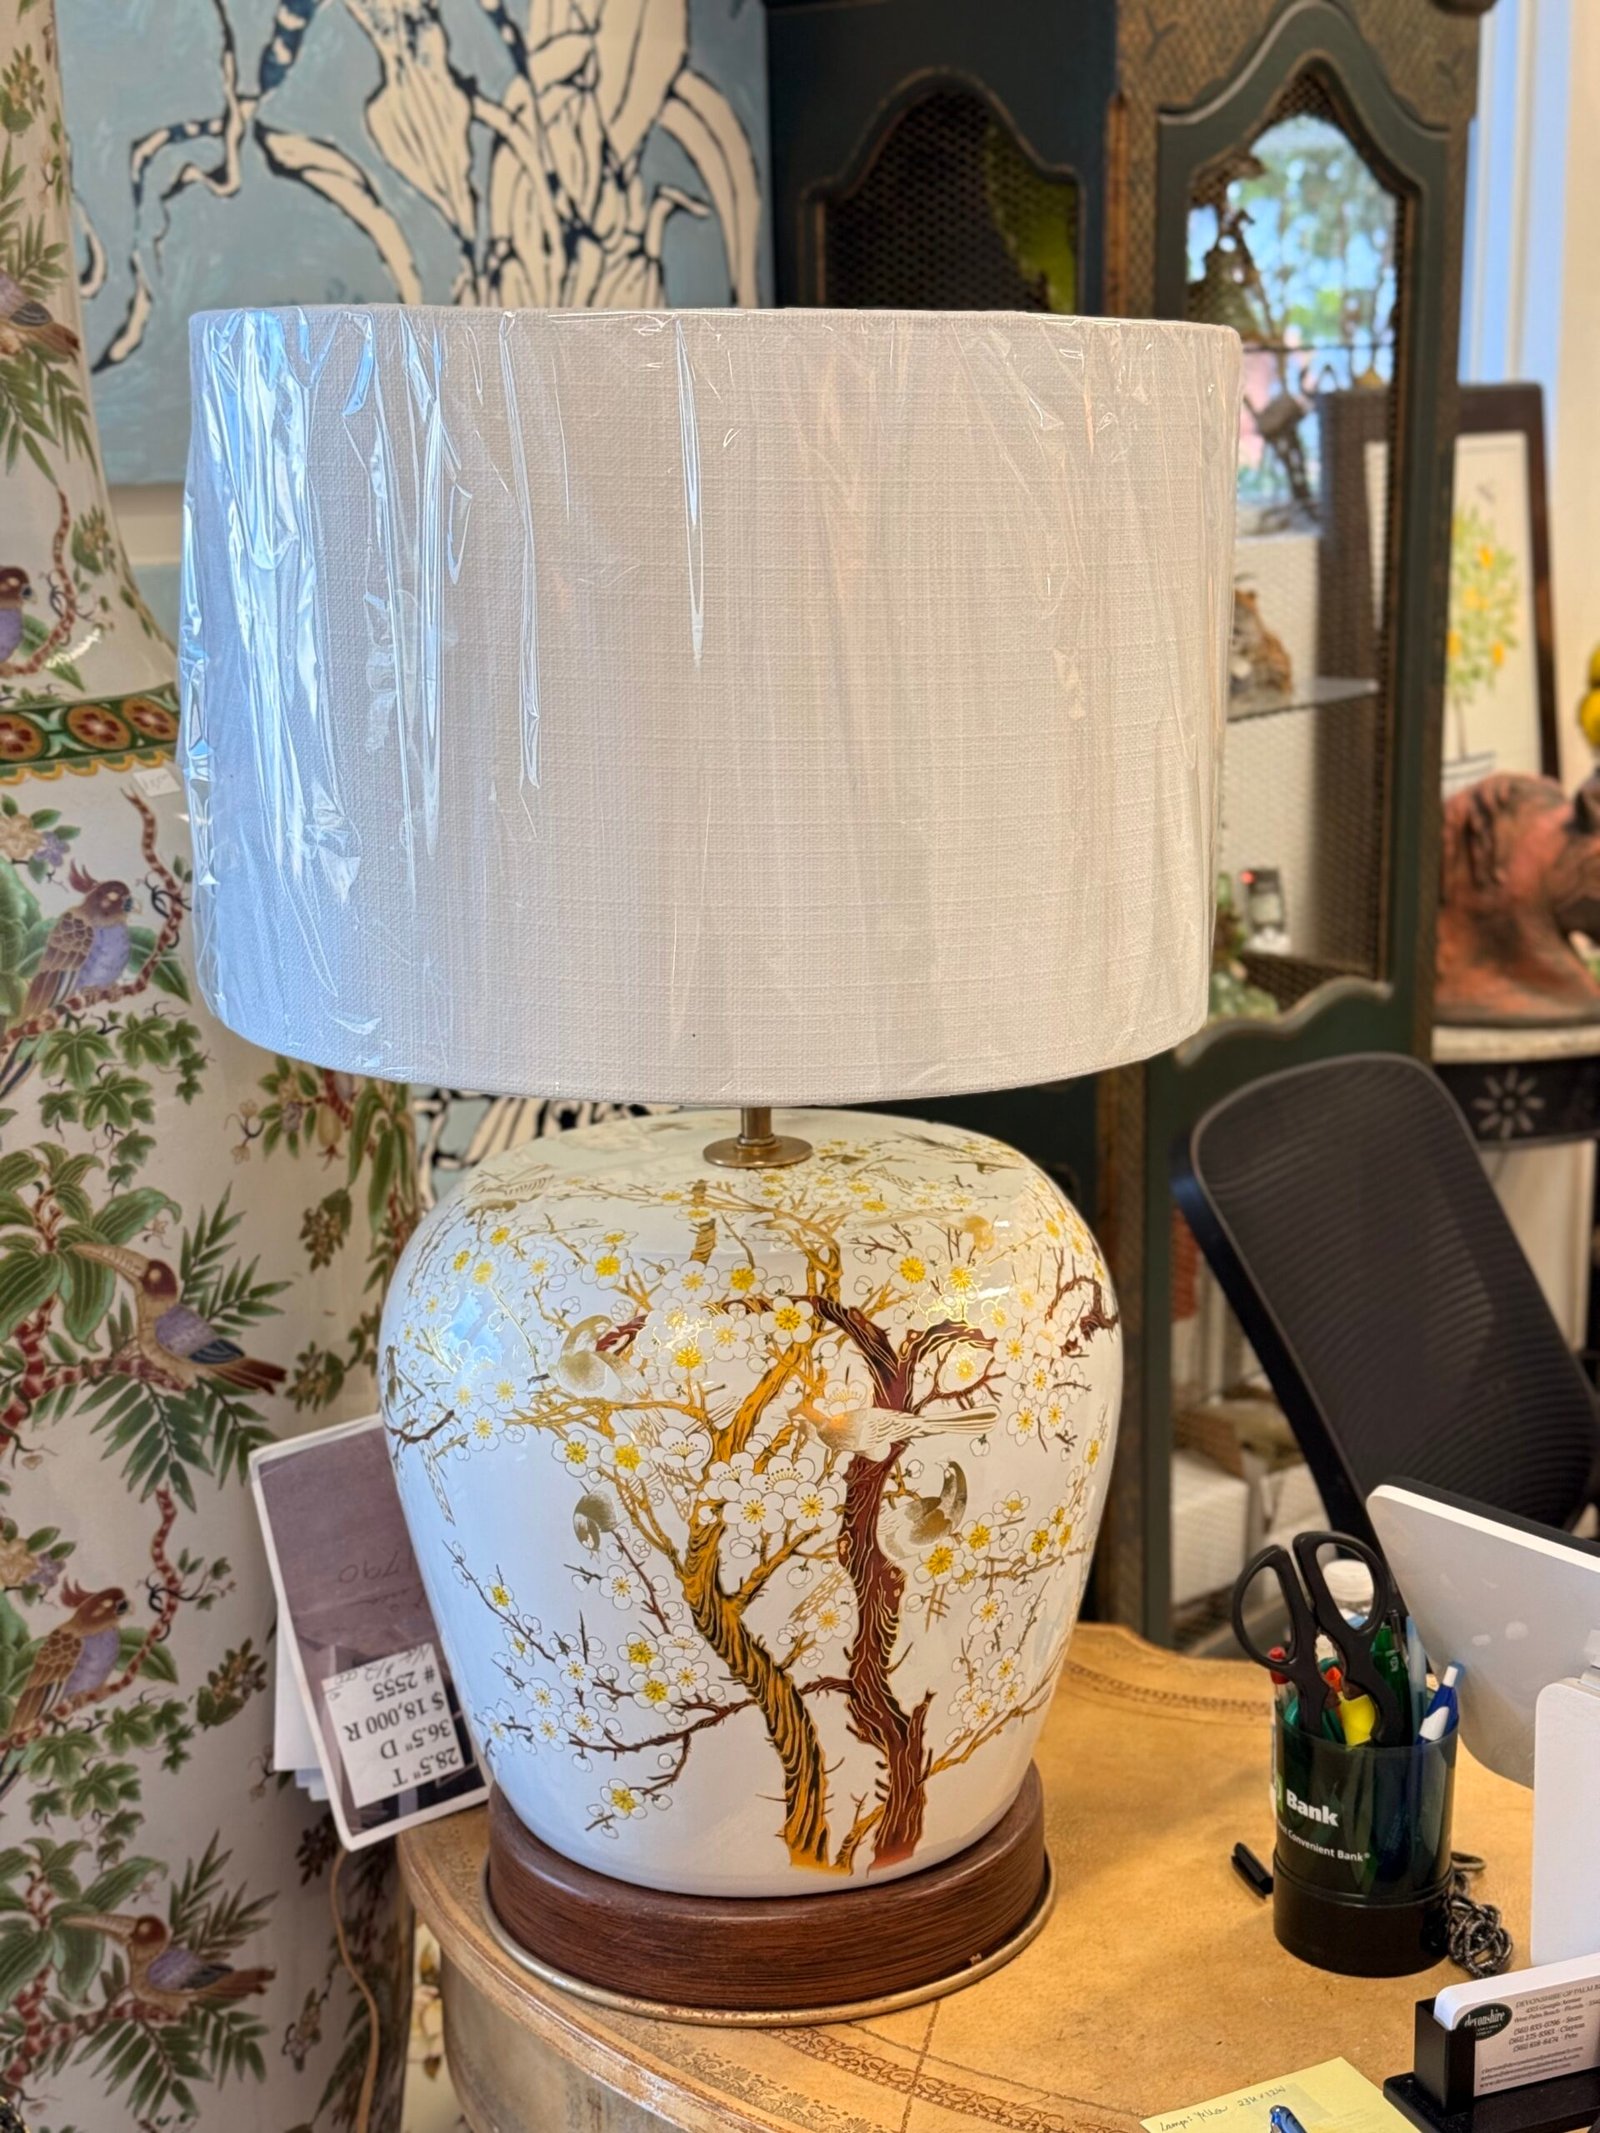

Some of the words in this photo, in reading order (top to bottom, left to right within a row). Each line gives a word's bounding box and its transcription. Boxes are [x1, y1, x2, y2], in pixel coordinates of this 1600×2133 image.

[372, 1670, 418, 1701] 2555
[423, 1665, 435, 1683] #
[431, 1691, 445, 1711] $
[366, 1699, 428, 1735] 18,000
[343, 1723, 362, 1742] R
[404, 1718, 451, 1752] 36.5"
[380, 1738, 400, 1760] D
[412, 1747, 459, 1779] 28.5"
[391, 1767, 409, 1788] T
[1286, 1788, 1339, 1827] Bank
[1288, 1829, 1335, 1857] Convenient
